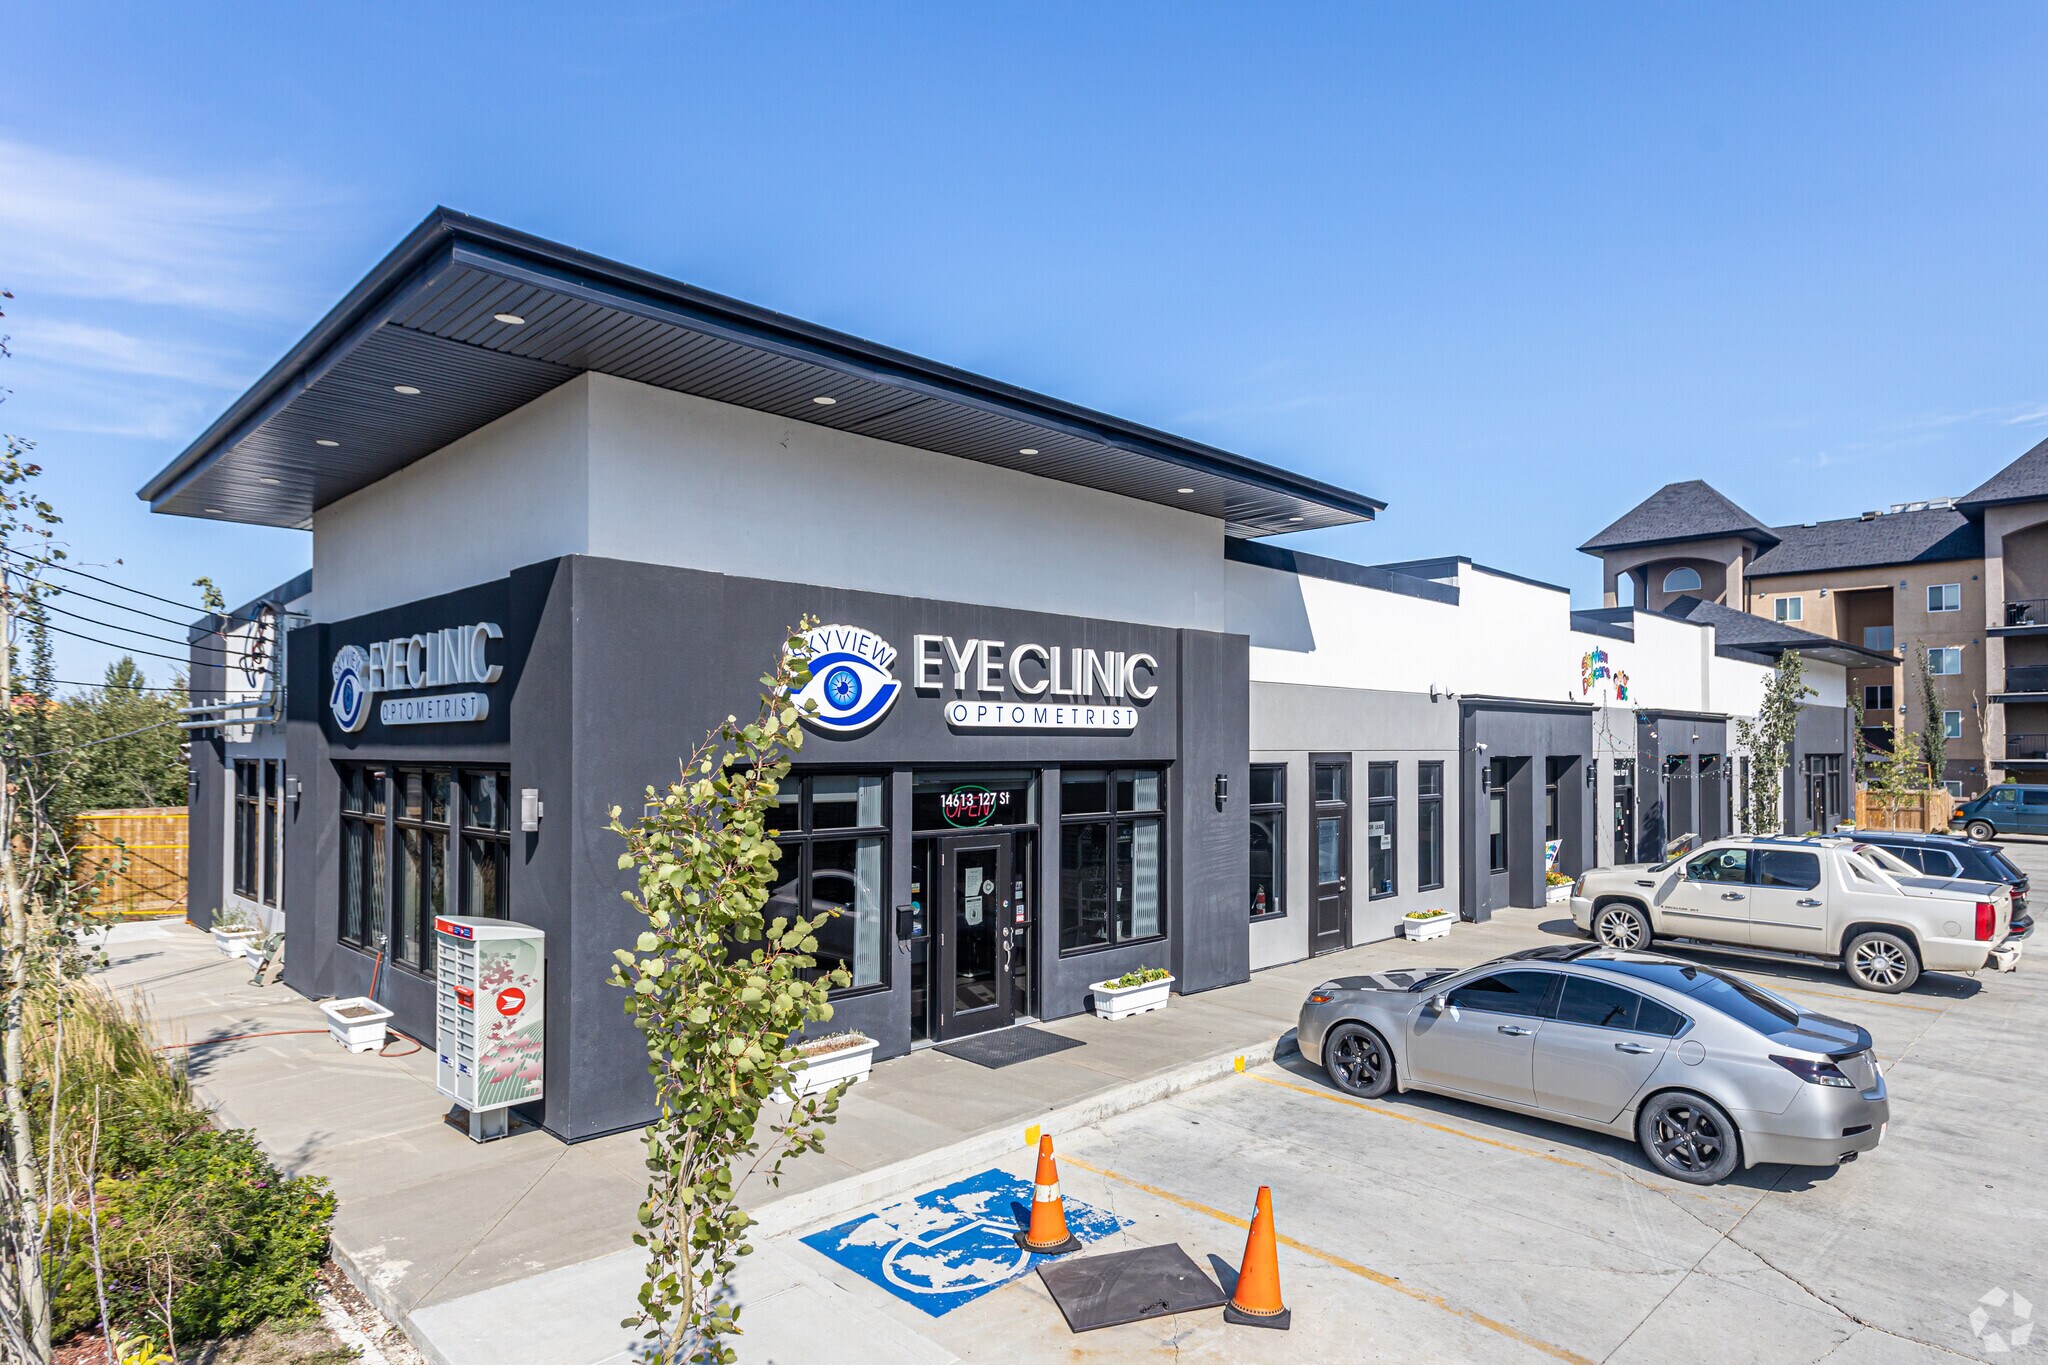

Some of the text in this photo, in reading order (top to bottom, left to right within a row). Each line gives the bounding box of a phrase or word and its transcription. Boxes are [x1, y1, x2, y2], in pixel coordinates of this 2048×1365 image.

[383, 697, 476, 721] OPTOMETRIST
[953, 704, 1134, 725] OPTOMETRIST
[941, 791, 1010, 808] 14613 127 St
[945, 796, 991, 818] OPEN
